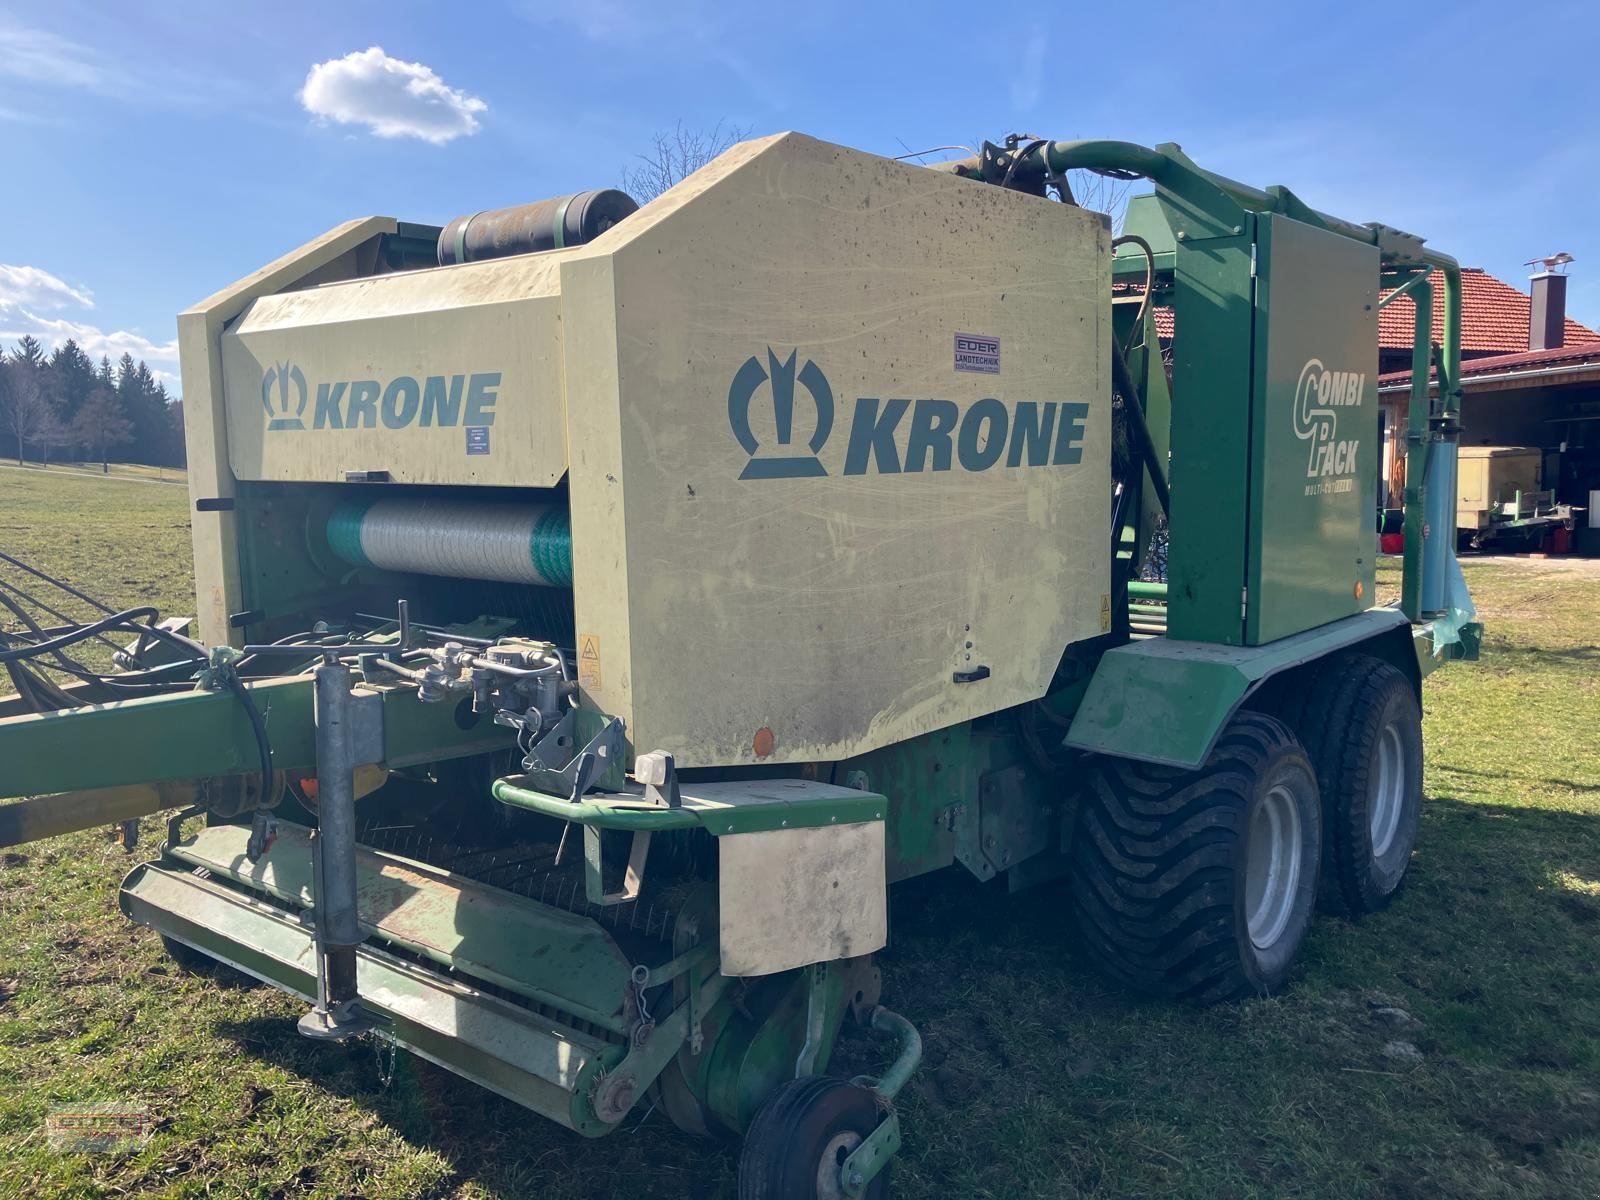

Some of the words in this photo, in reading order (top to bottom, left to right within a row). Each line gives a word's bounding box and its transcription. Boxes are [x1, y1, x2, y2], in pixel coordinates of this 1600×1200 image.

[955, 353, 999, 366] LANDTECHNIK
[957, 339, 997, 354] EDER
[312, 372, 502, 430] KRONE
[843, 398, 1090, 476] KRONE
